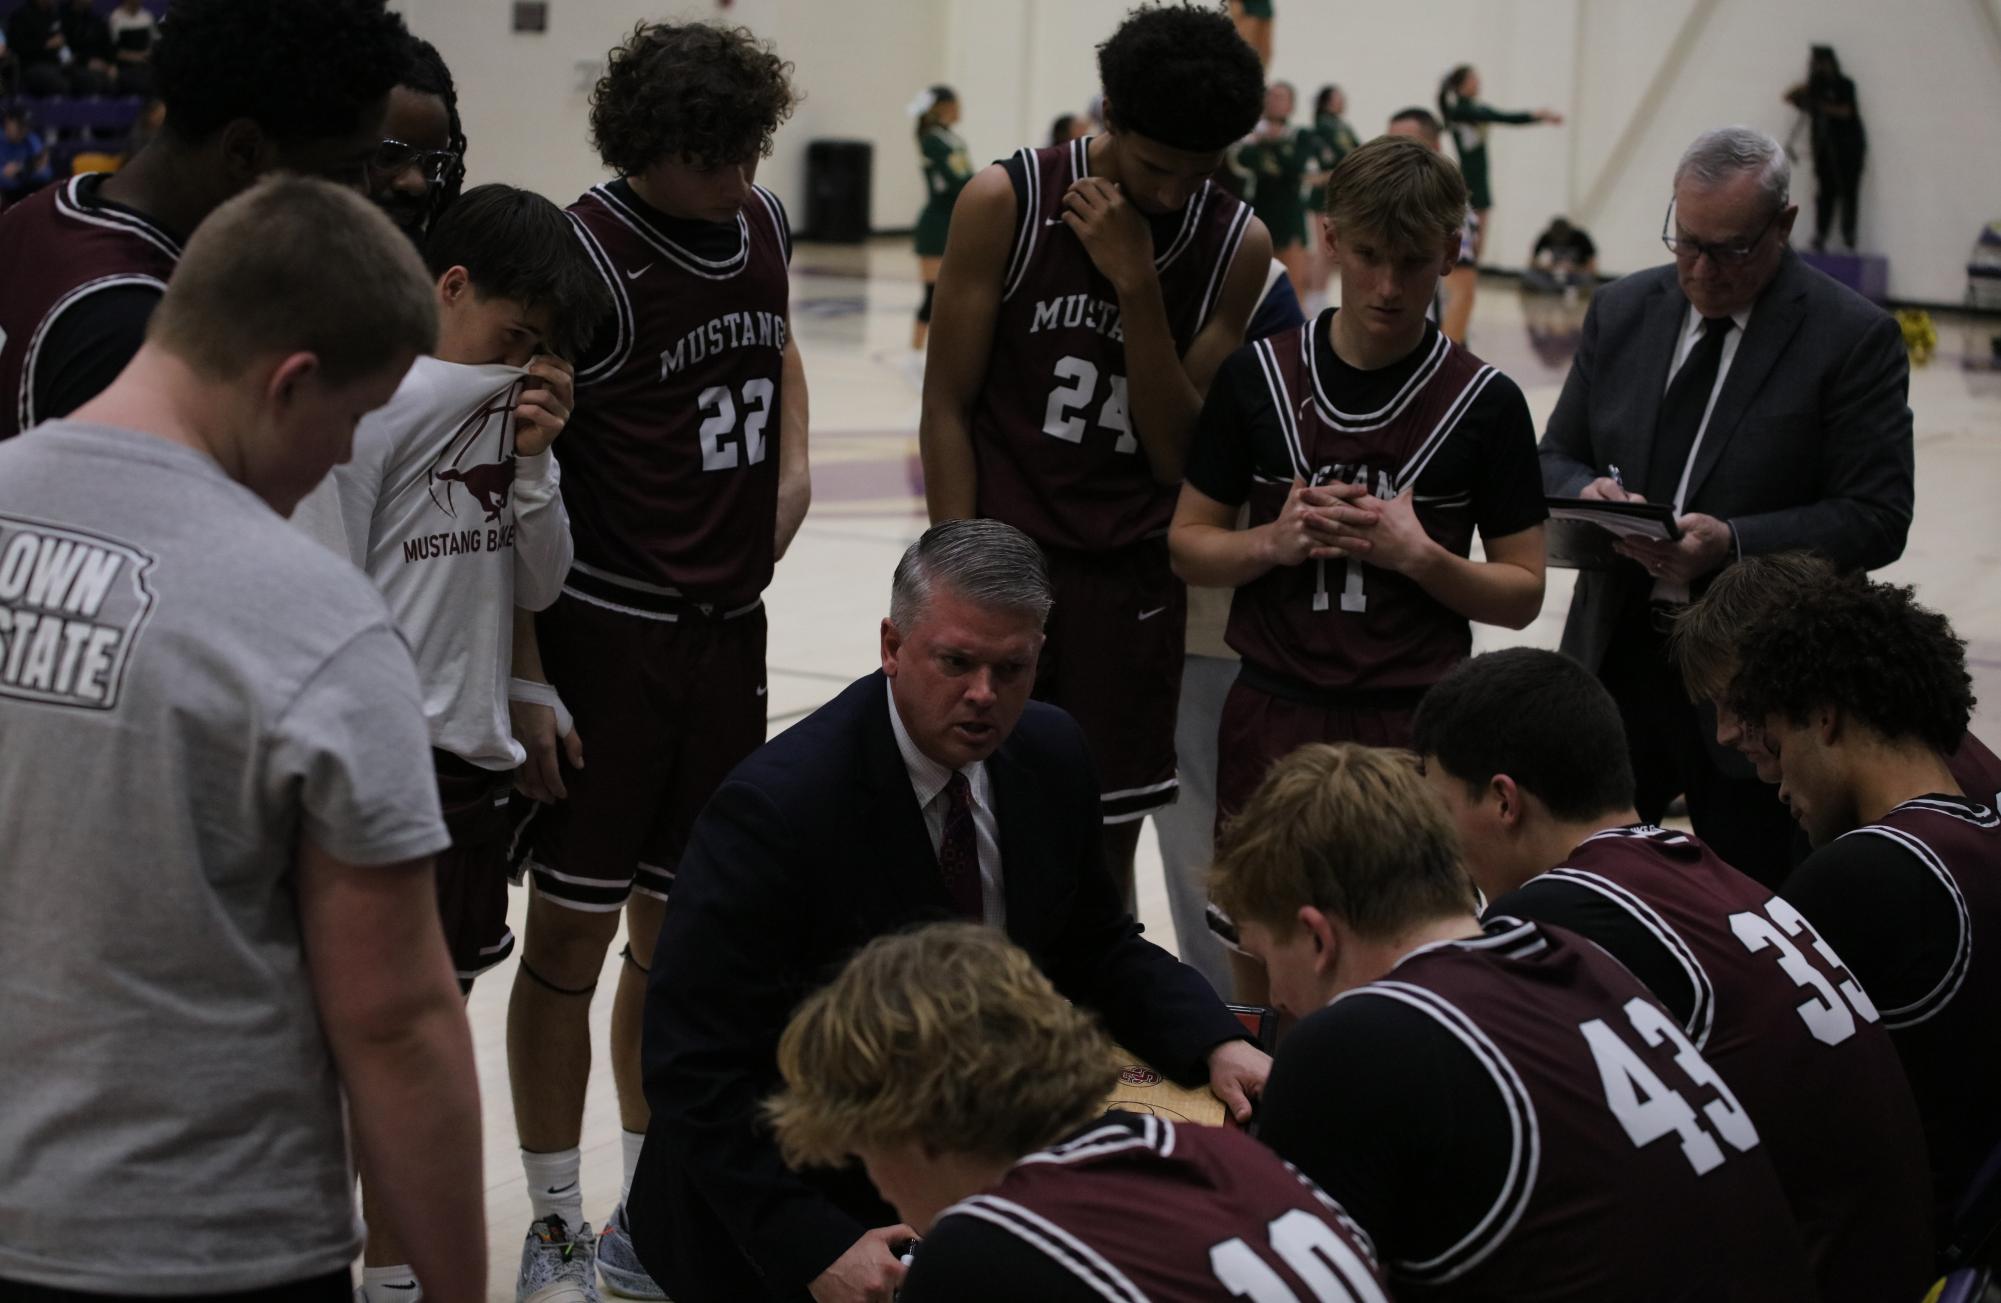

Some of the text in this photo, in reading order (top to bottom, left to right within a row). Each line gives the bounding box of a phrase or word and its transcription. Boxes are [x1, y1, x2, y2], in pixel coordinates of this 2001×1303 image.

[697, 377, 775, 473] 22
[1041, 354, 1139, 455] 24
[403, 529, 481, 563] MUSTANG
[1728, 894, 1881, 1048] 33
[1578, 996, 1761, 1177] 43
